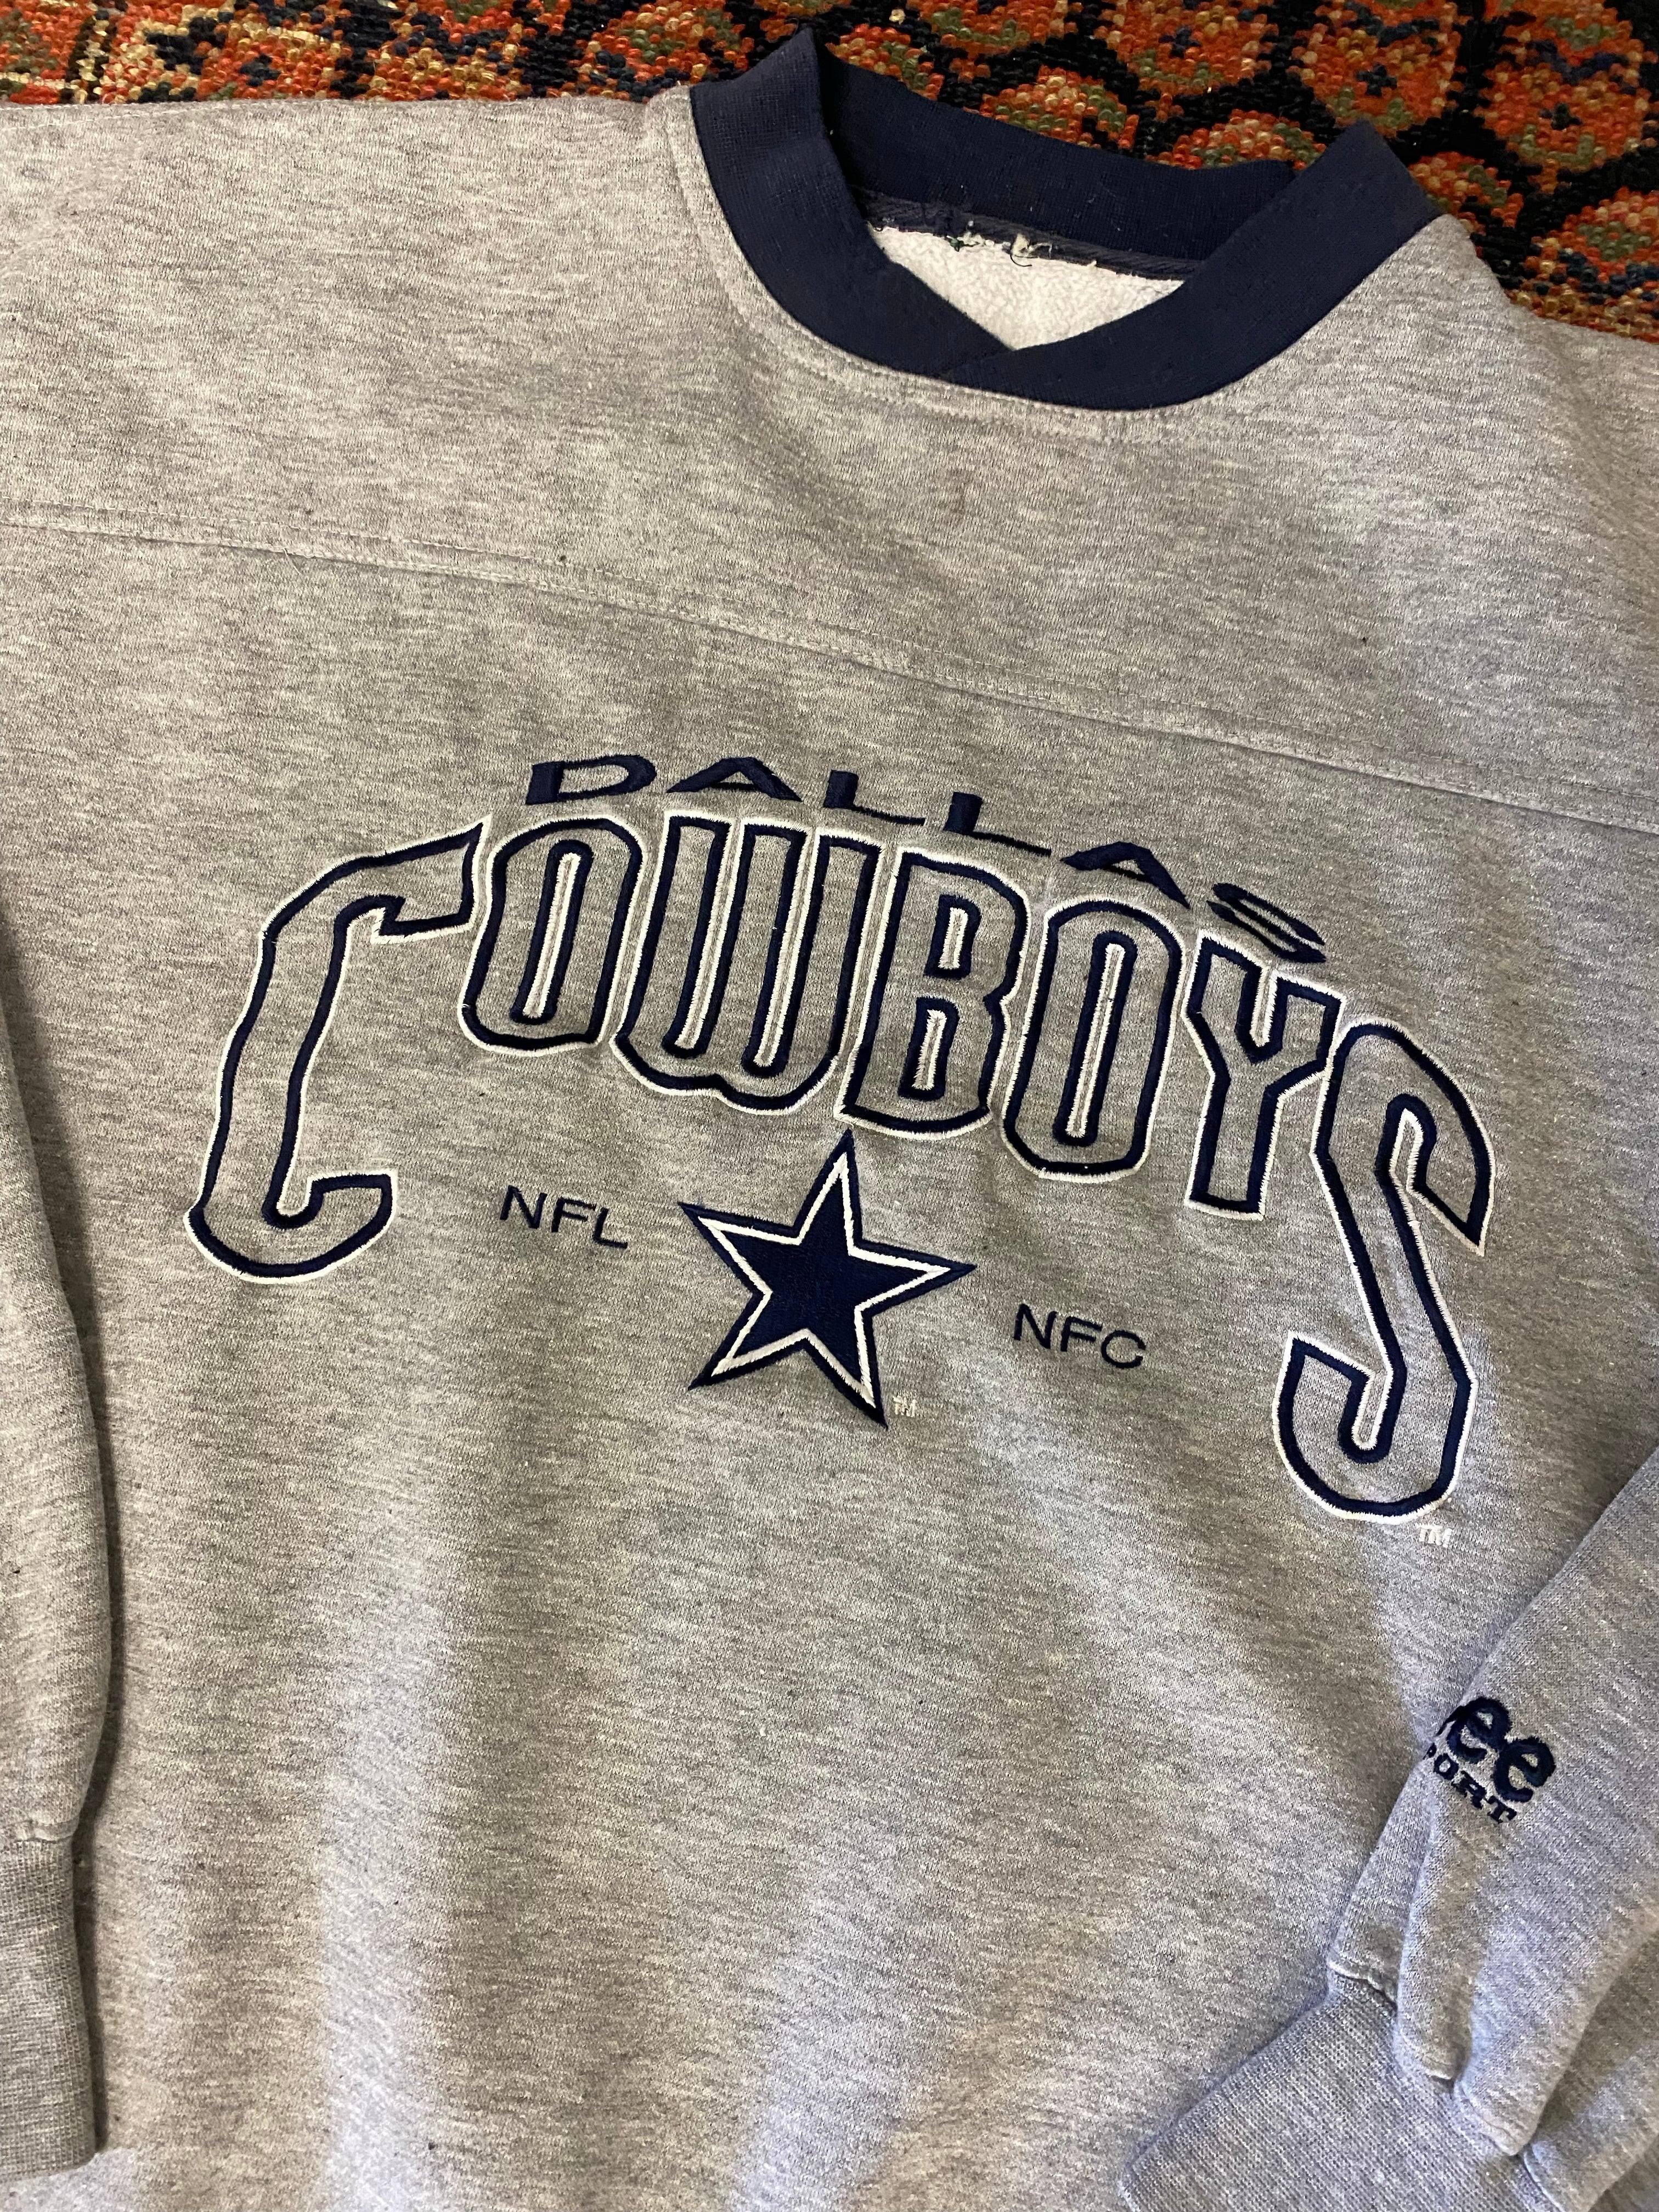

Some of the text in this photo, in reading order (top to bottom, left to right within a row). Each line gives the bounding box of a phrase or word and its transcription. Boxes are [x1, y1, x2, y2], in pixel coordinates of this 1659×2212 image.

[526, 754, 1327, 963] DALLAS
[187, 808, 1494, 1524] COWBOYS
[499, 1185, 628, 1249] NFL
[1014, 1304, 1146, 1369] NFC
[1415, 1522, 1453, 1548] TM
